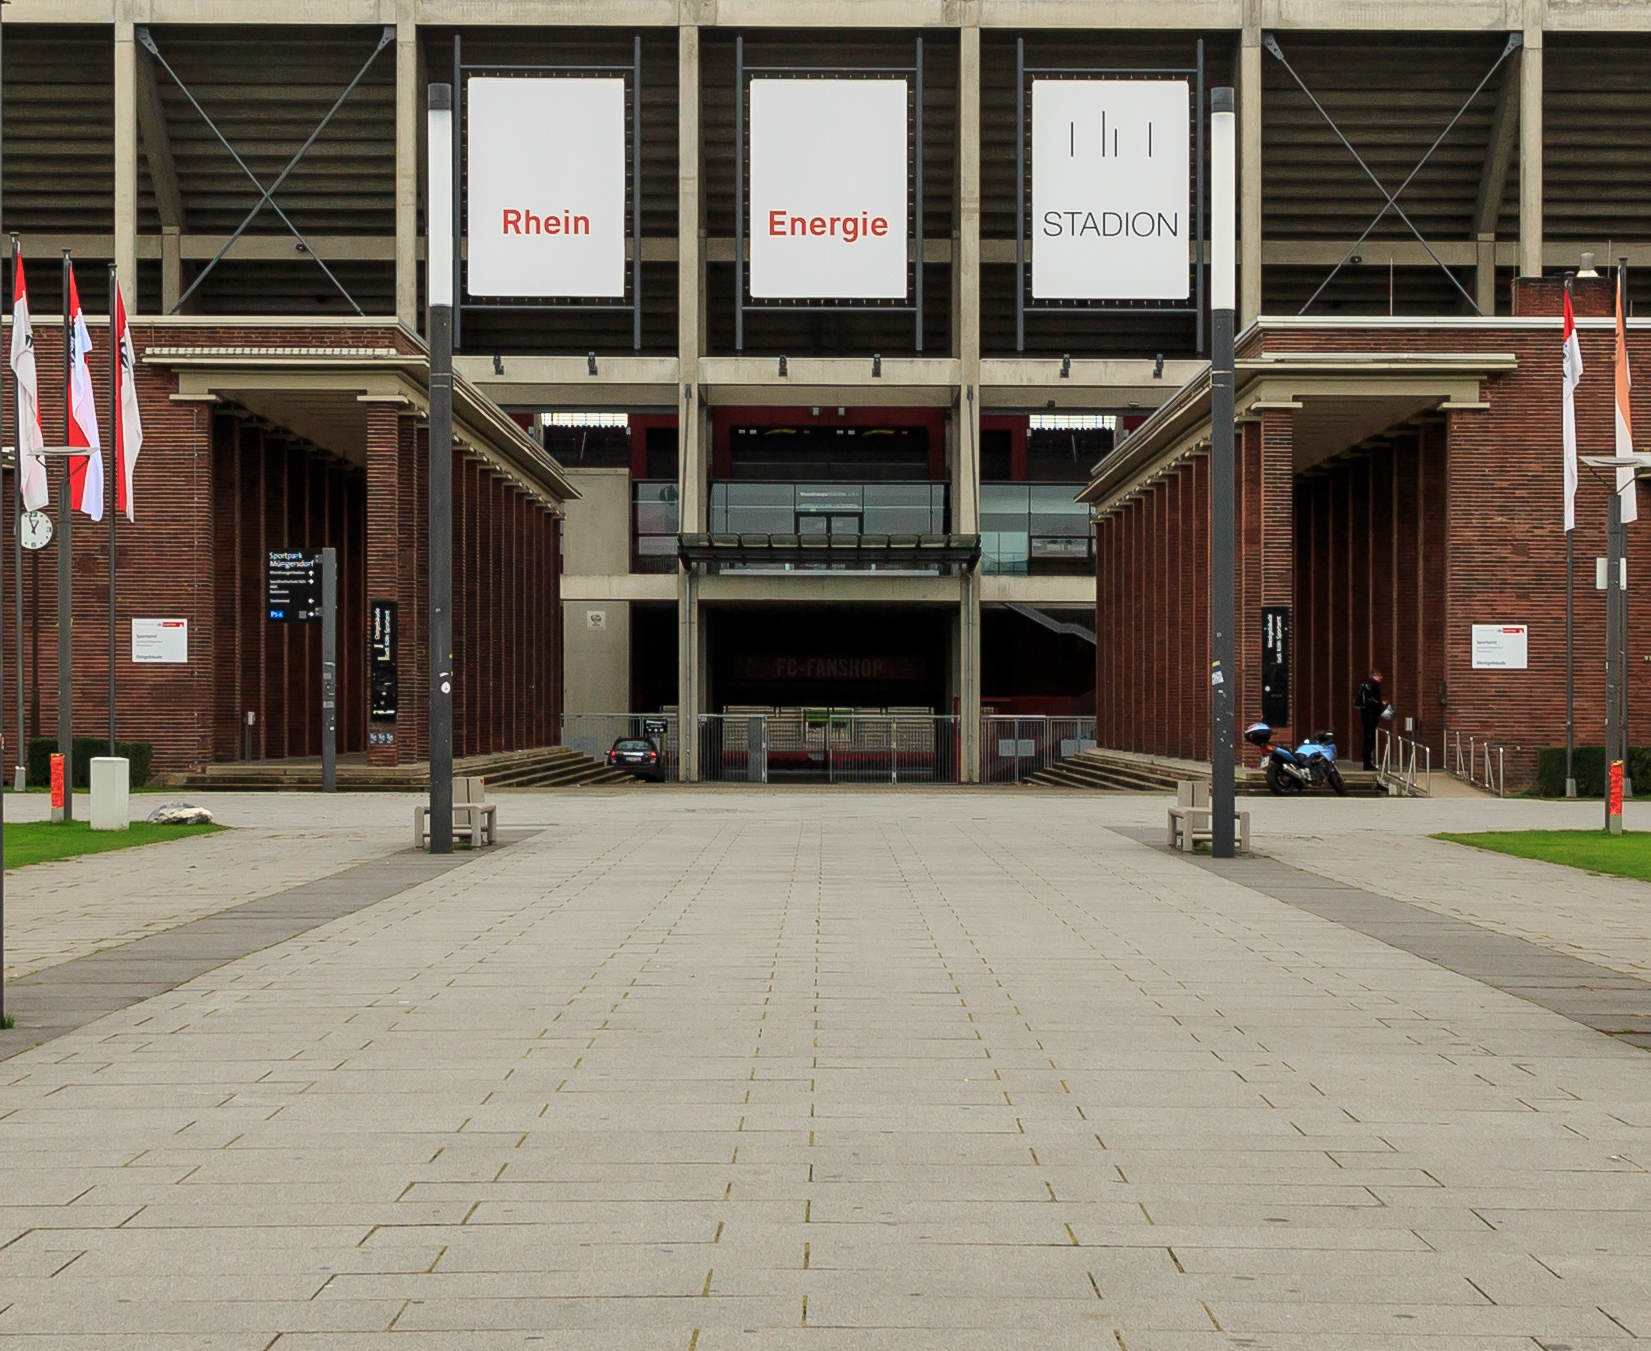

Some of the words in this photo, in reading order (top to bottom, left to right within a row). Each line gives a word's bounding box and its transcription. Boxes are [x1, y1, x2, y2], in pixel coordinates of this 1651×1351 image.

[502, 209, 590, 234] Rhein
[769, 211, 888, 242] Energie
[1043, 211, 1178, 237] STADION
[775, 657, 883, 676] FC-FANSHOP
